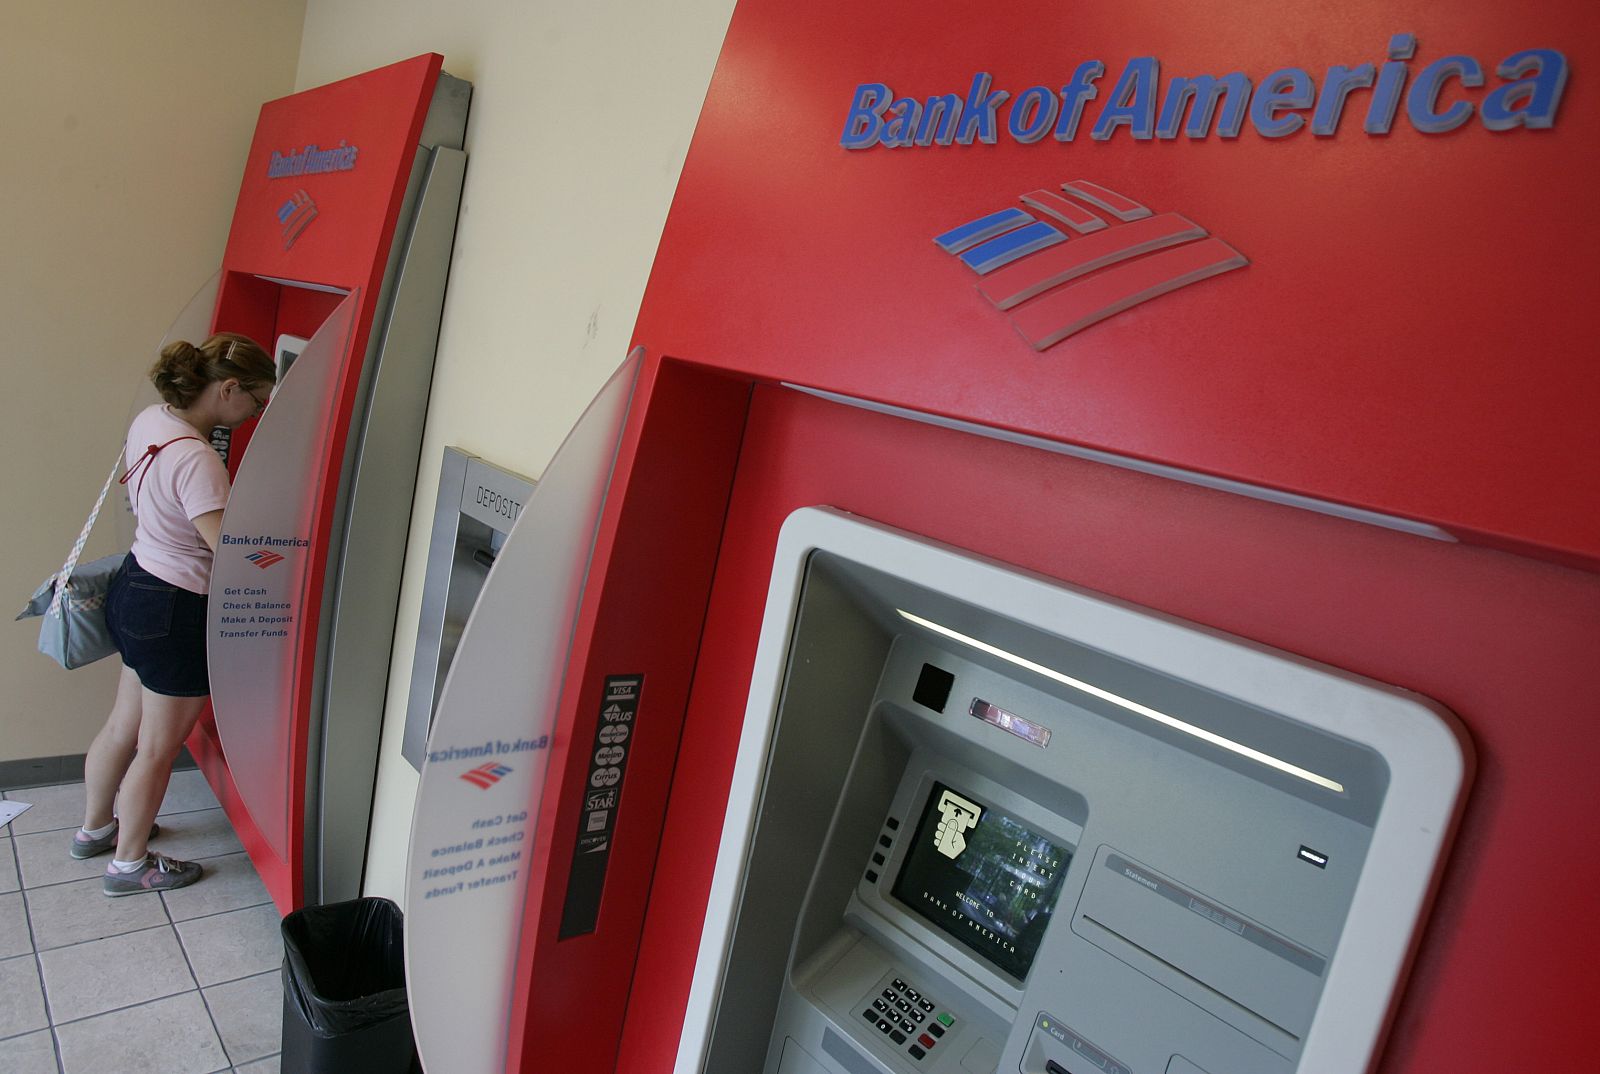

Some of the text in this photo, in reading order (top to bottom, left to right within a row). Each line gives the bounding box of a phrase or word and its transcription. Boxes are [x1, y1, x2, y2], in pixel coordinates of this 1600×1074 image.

[840, 33, 1568, 149] Bank of America
[476, 485, 524, 521] DEPOSIT
[222, 534, 310, 548] Bank of America
[224, 587, 267, 596] Get Cash
[222, 601, 292, 610] Check Balance
[221, 615, 294, 625] Make A Deposit
[219, 629, 288, 639] Transfer Funds
[613, 686, 632, 695] VISA
[610, 711, 633, 722] PLUS
[597, 752, 623, 761] Maestro
[594, 771, 619, 782] Cirrus
[586, 796, 614, 810] STAR
[1016, 841, 1059, 869] PLEASE
[1012, 853, 1054, 880] INSERT
[1014, 868, 1042, 888] YOUR
[1124, 868, 1159, 891] Statement
[1009, 880, 1037, 900] CARD
[955, 890, 995, 919] WELCOME TO
[923, 891, 1016, 954] BANK OF AMERICA
[1050, 1027, 1065, 1041] Card
